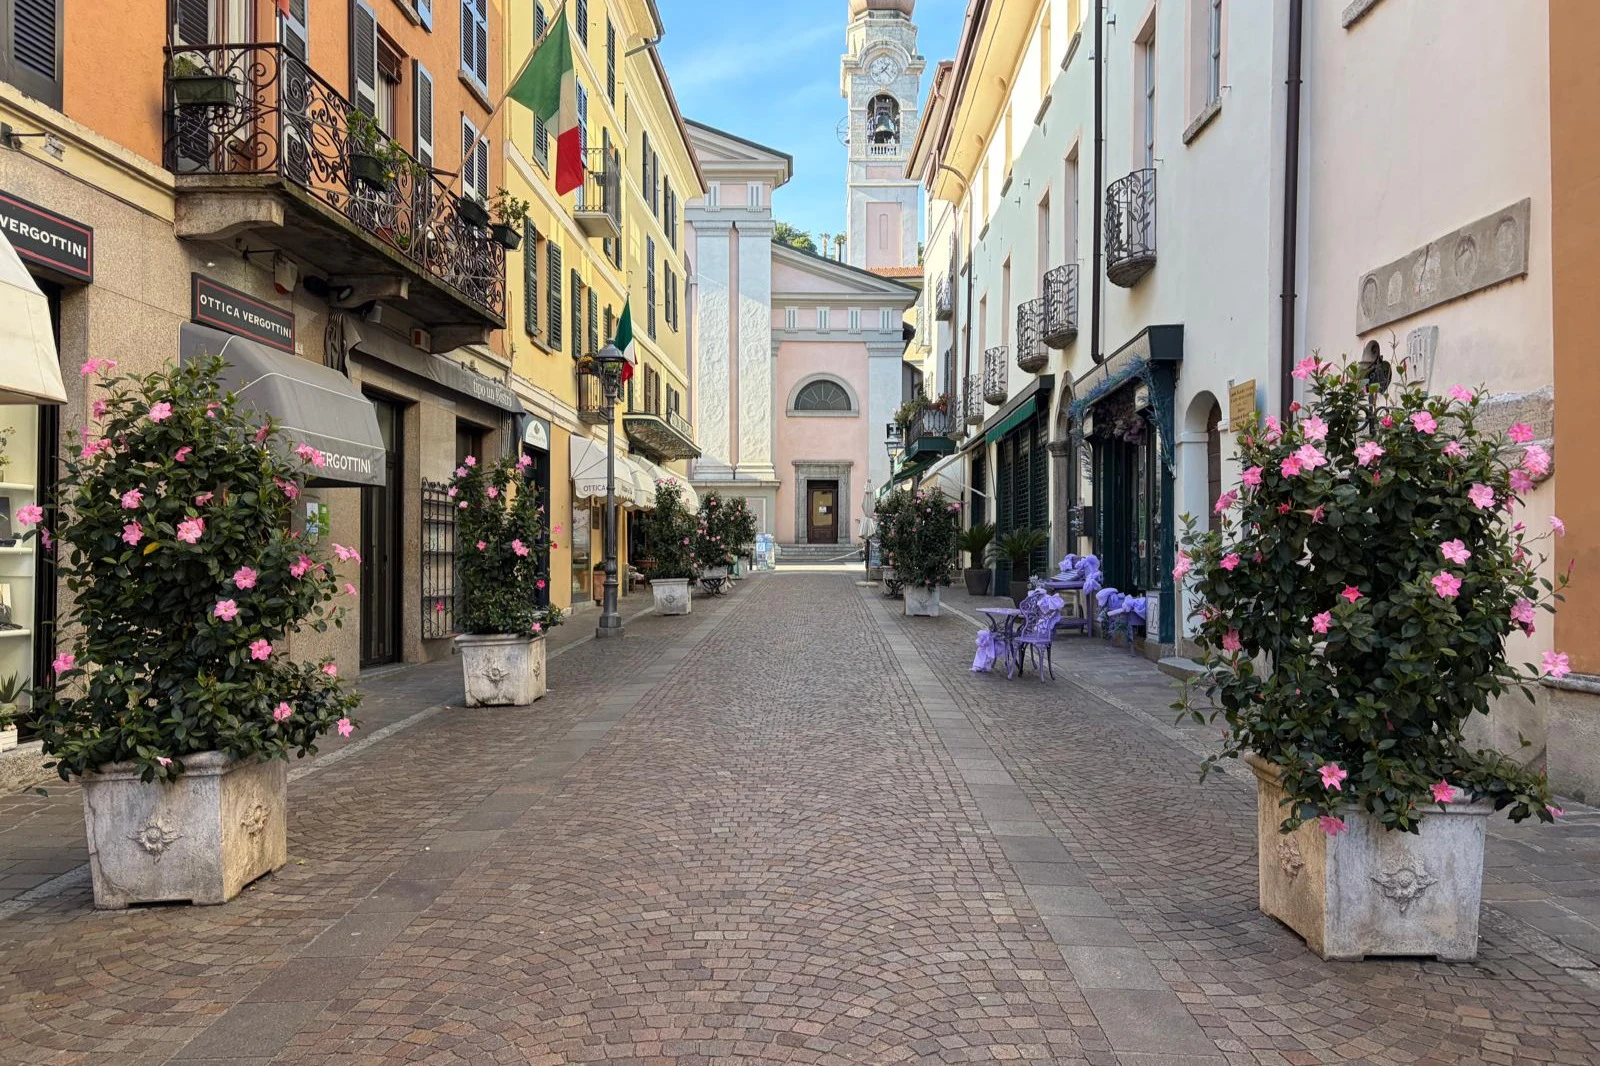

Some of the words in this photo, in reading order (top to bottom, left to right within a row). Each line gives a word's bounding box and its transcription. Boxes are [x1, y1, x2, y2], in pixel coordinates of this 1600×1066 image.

[0, 214, 87, 259] VERGOTTINI
[200, 294, 240, 318] OTTICA
[242, 310, 292, 338] VERGOTTINI
[486, 386, 495, 401] un
[583, 484, 606, 492] OTTICA
